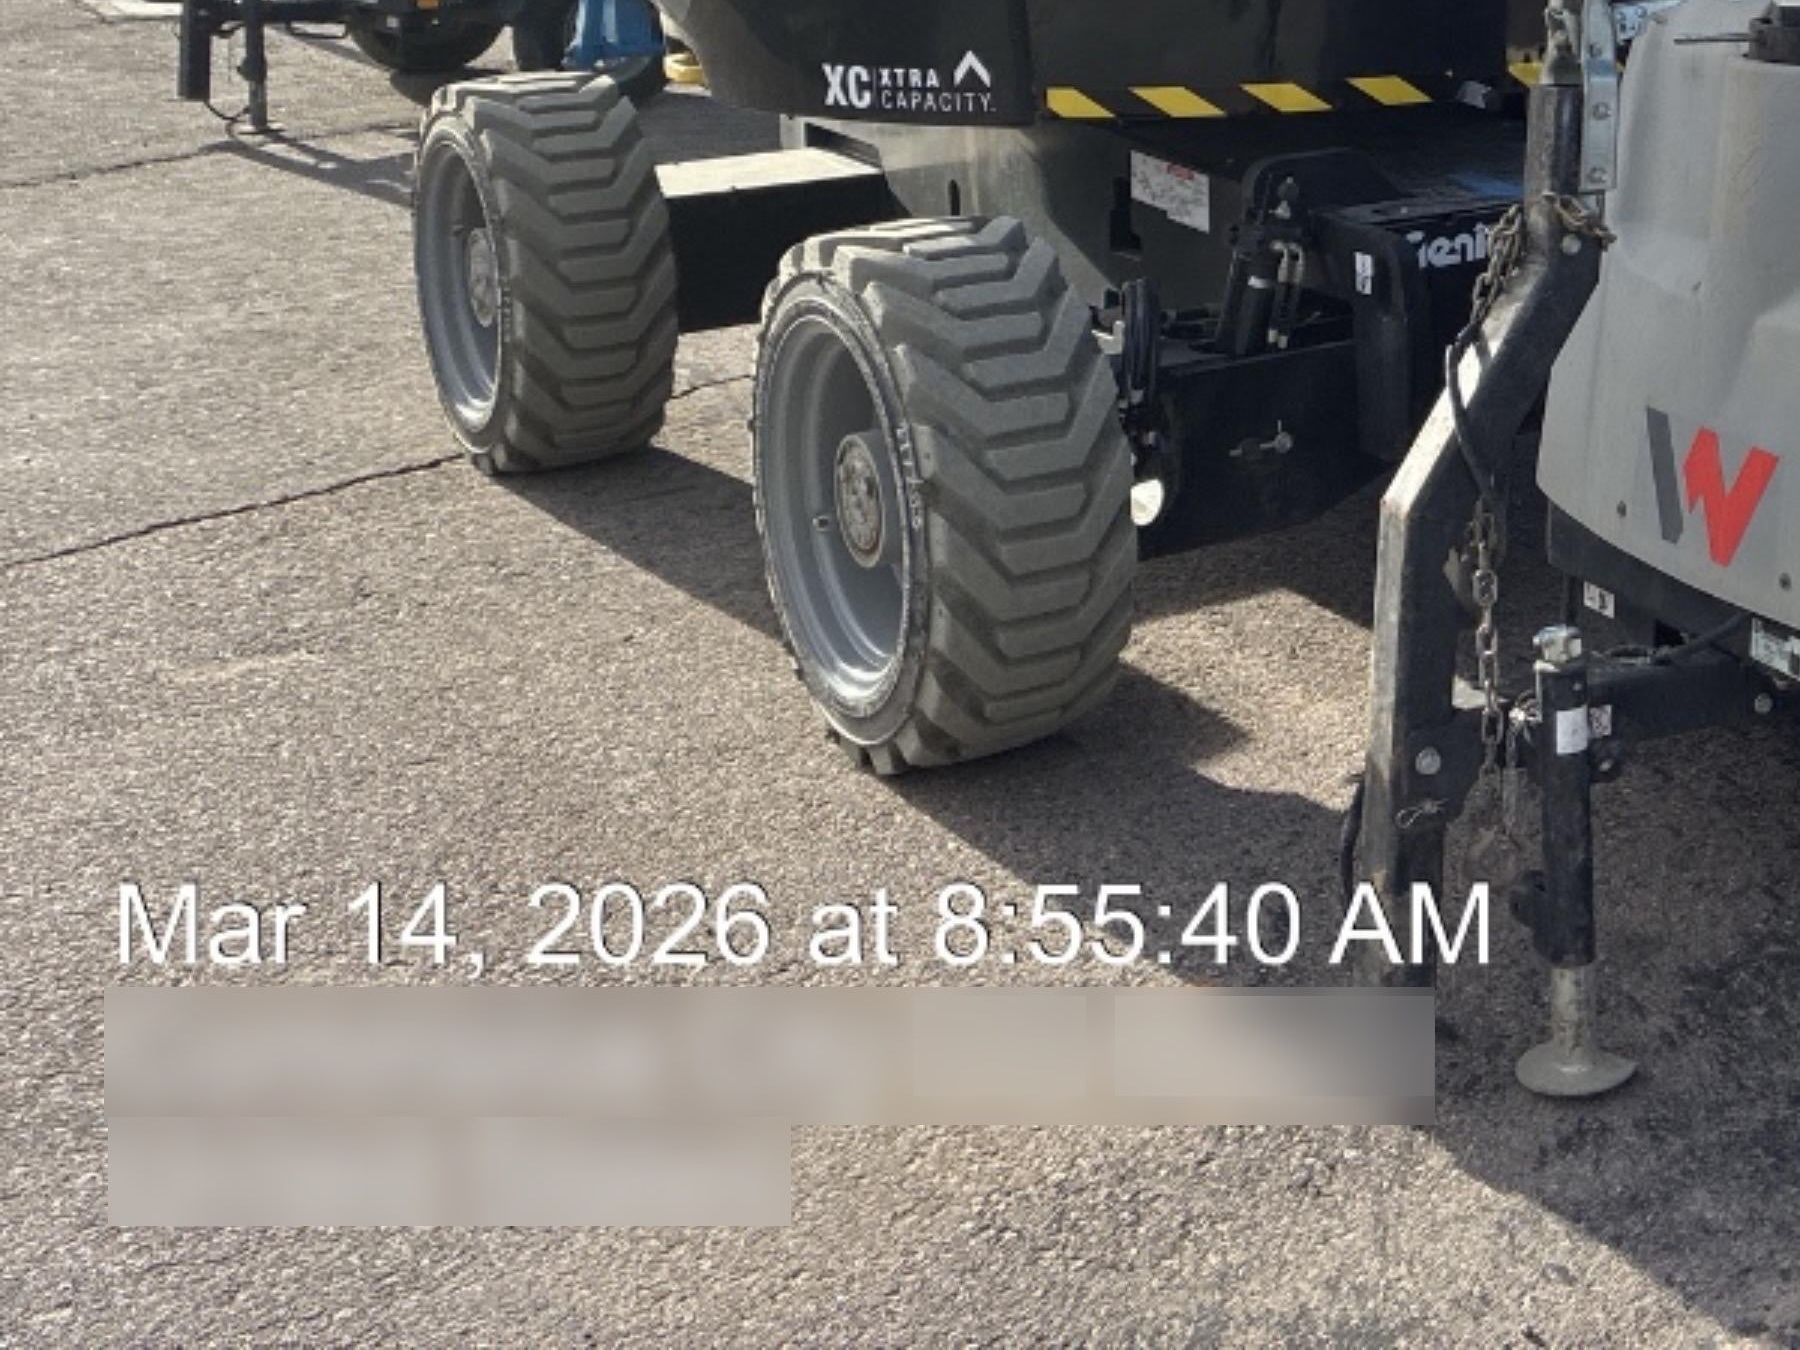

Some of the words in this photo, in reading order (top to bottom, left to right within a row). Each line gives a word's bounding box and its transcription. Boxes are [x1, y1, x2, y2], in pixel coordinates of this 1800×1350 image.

[821, 62, 873, 109] XC
[878, 67, 941, 88] XTRA
[880, 89, 992, 113] CAPACITY
